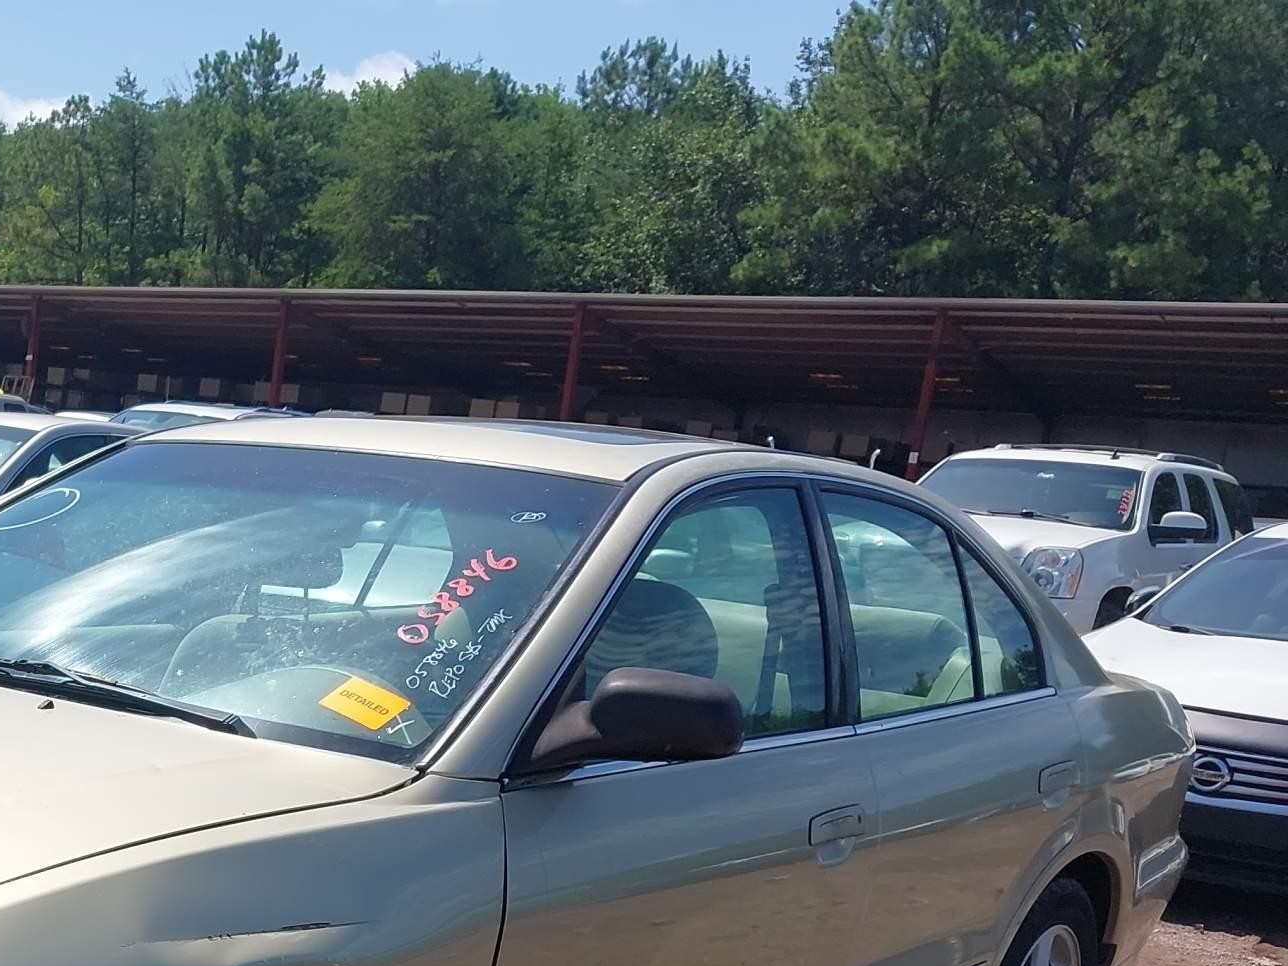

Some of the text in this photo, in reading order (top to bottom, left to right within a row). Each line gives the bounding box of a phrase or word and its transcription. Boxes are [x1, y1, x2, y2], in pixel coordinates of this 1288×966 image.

[397, 548, 518, 644] 058846
[428, 664, 465, 699] REPO
[339, 689, 390, 716] DETAILED
